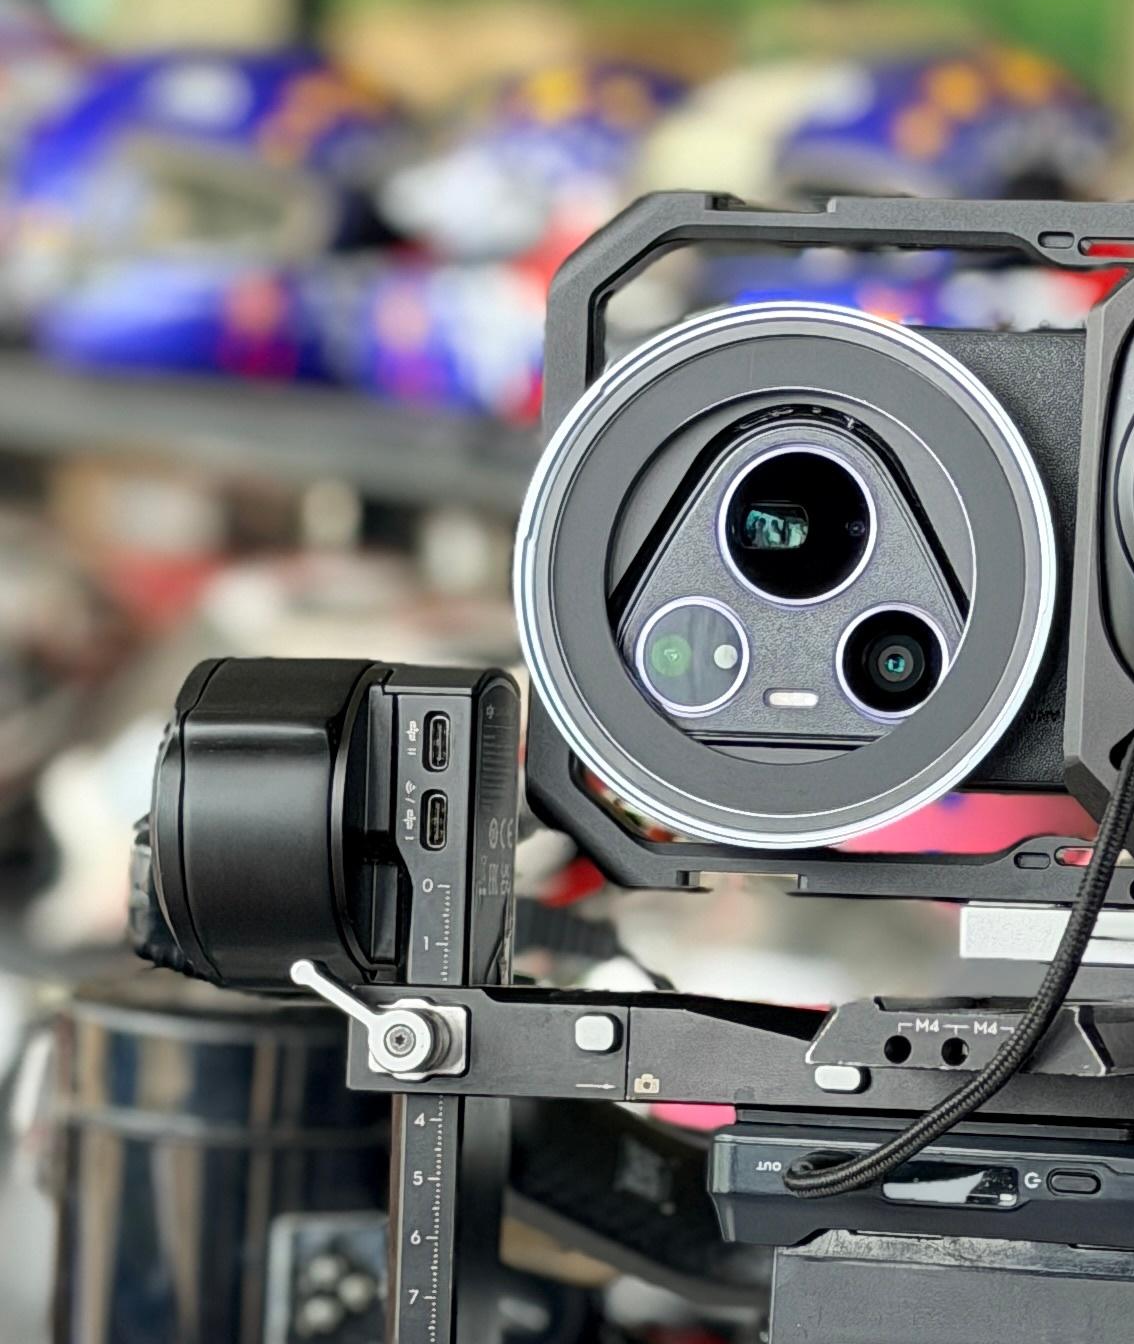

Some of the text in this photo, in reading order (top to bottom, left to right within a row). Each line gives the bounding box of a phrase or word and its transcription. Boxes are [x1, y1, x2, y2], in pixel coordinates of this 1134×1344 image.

[422, 878, 434, 893] 0
[423, 935, 429, 951] 1
[915, 1018, 998, 1035] M4 M4
[413, 1112, 426, 1127] 4
[755, 1160, 782, 1172] OUT
[412, 1170, 423, 1186] 5
[410, 1229, 421, 1245] 6
[408, 1288, 420, 1305] 7
